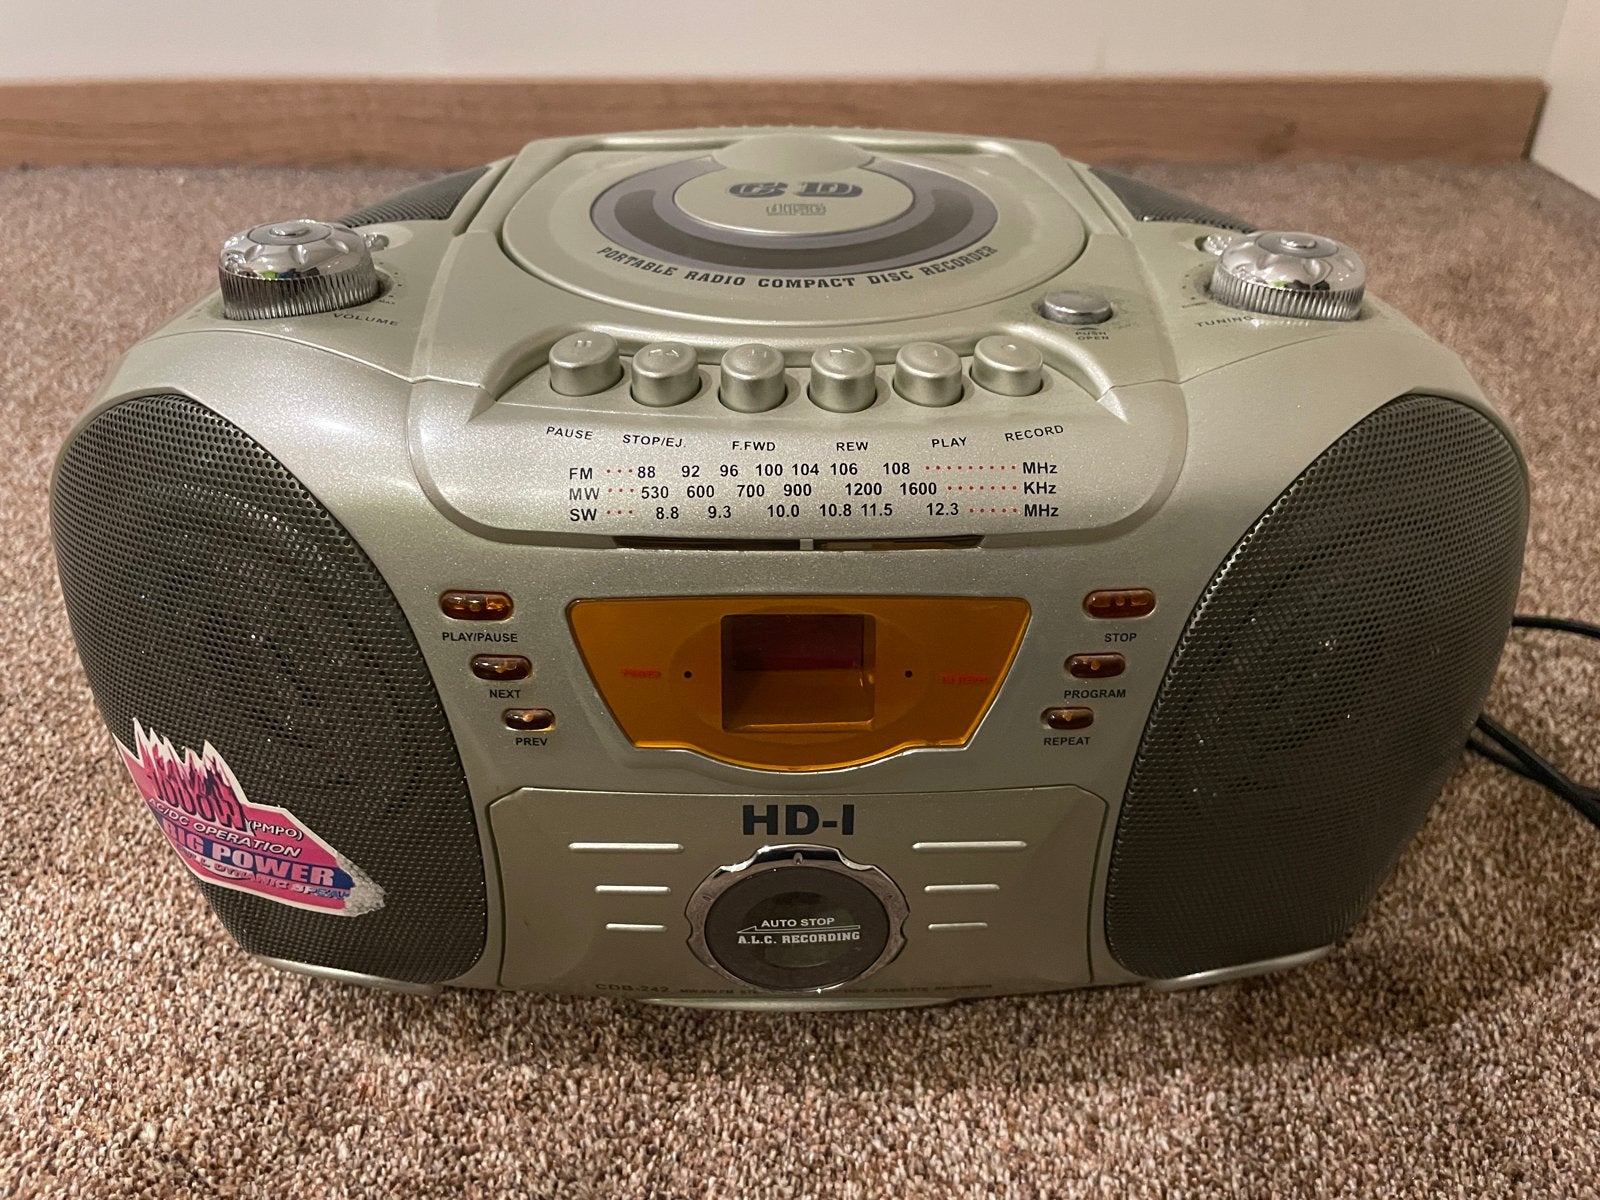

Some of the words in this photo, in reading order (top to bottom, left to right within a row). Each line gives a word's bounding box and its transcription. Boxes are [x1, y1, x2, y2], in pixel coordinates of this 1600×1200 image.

[597, 246, 678, 276] PORTABLE
[684, 271, 746, 286] RADIO
[758, 277, 855, 289] COMPACT
[867, 270, 914, 285] DISC
[920, 245, 998, 276] RECORDER
[333, 312, 399, 326] VOLUME
[1195, 315, 1256, 328] TUNING
[546, 426, 594, 441] PAUSE
[1004, 424, 1065, 442] RECORD
[622, 434, 687, 448] STOP/EJ.
[732, 440, 776, 452] F.FWD
[836, 441, 869, 452] REW
[931, 437, 967, 448] PLAY
[569, 467, 594, 480] FM
[637, 465, 656, 479] 88
[681, 465, 700, 478] 92
[719, 464, 739, 477] 96
[755, 463, 784, 477] 100
[792, 463, 820, 476] 104
[830, 462, 858, 475] 106
[883, 462, 911, 475] 108
[1022, 462, 1058, 474] MHz
[569, 487, 600, 501] MW
[641, 486, 669, 499] 530
[686, 485, 715, 498] 600
[737, 484, 765, 497] 700
[783, 483, 812, 497] 900
[844, 482, 882, 496] 1200
[900, 482, 937, 496] 1600
[1023, 481, 1057, 495] KHz
[569, 508, 597, 522] SW
[655, 506, 680, 520] 8.8
[707, 505, 732, 519] 9.3
[767, 504, 800, 518] 10.0
[819, 503, 852, 517] 10.8
[860, 503, 893, 517] 11.5
[926, 502, 959, 516] 12.3
[1024, 504, 1059, 517] MHz
[442, 631, 518, 643] PLAY/PAUSE
[1104, 632, 1137, 642] STOP
[489, 689, 521, 699] NEXT
[1063, 689, 1126, 699] PROGRAM
[515, 737, 548, 746] PREV
[1043, 736, 1091, 746] REPEAT
[742, 804, 855, 836] HD-I
[149, 797, 190, 826] AC/DC
[193, 822, 302, 858] OPERATION
[248, 819, 305, 841] (PMPO)
[162, 818, 204, 854] BIG
[212, 843, 334, 887] POWER
[761, 919, 797, 928] AUTO
[800, 917, 835, 927] STOP
[738, 935, 777, 944] A.L.C.
[782, 931, 860, 944] RECORDING
